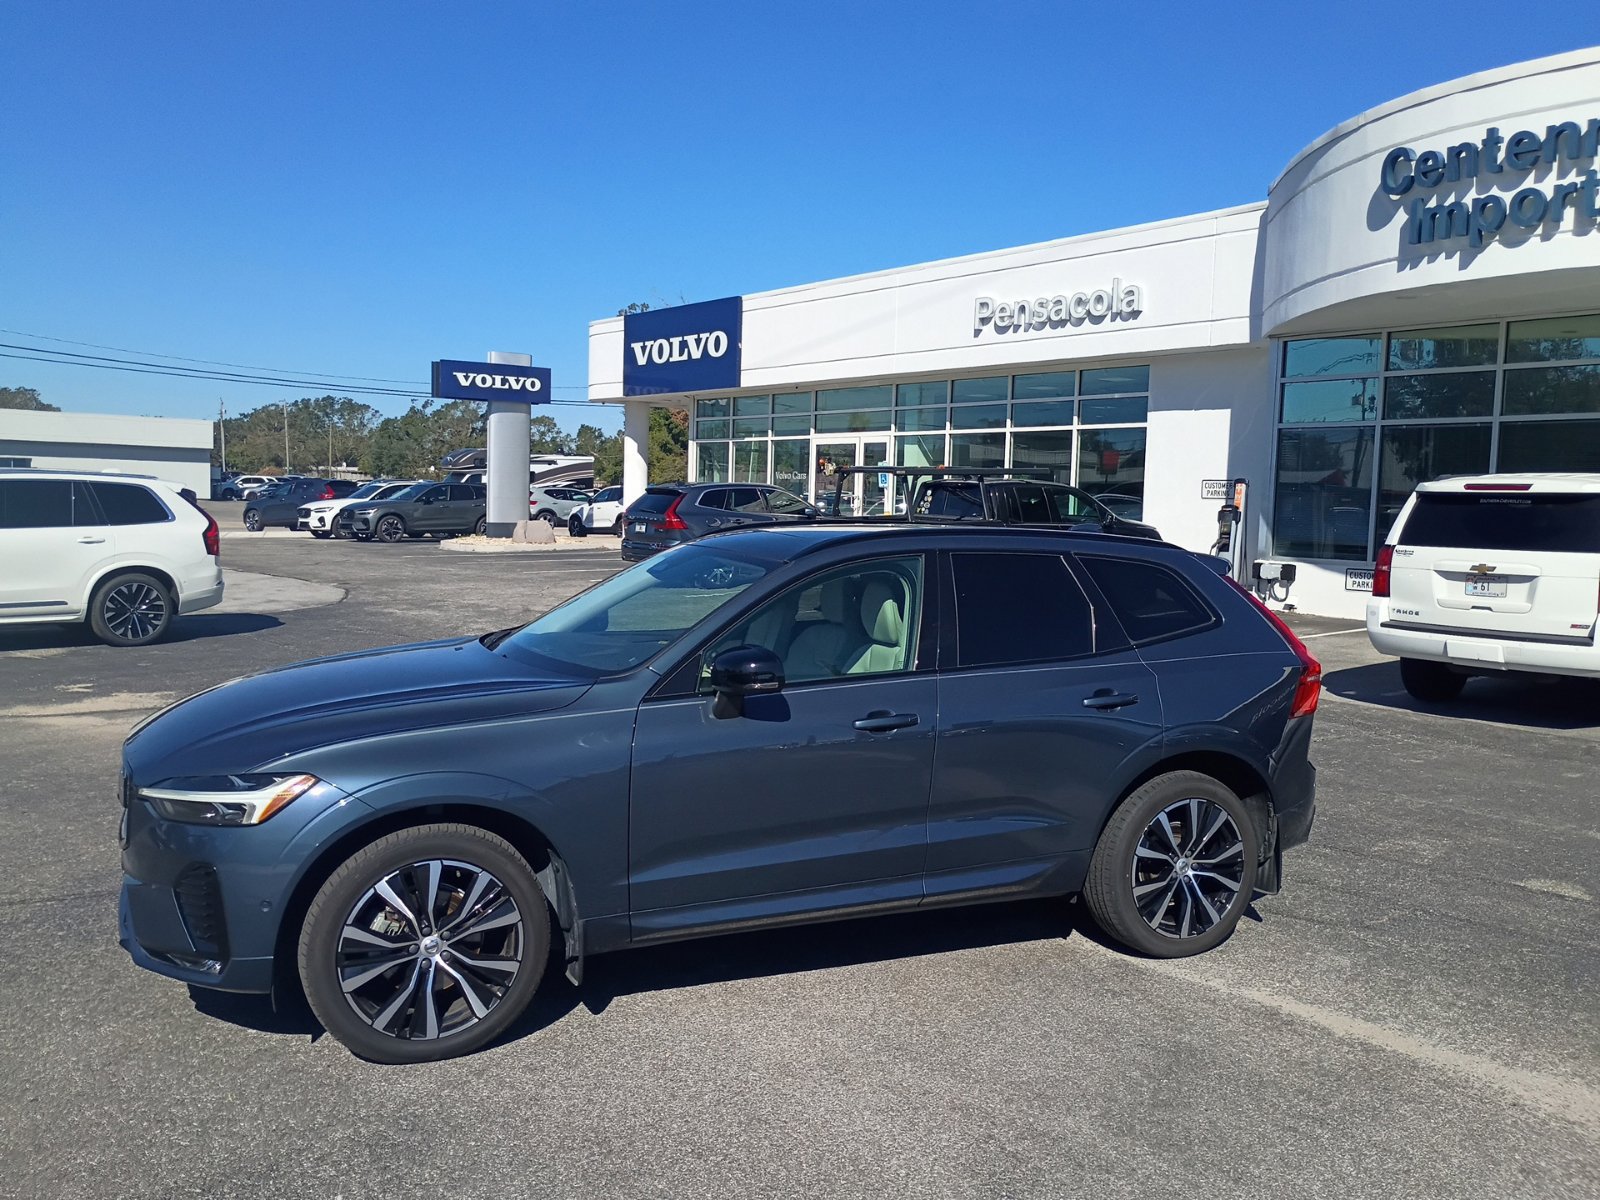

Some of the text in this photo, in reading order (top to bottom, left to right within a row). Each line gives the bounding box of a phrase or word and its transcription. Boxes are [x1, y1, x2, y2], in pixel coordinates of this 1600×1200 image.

[974, 277, 1141, 332] Pensacola
[631, 331, 728, 366] VOLVO
[453, 371, 542, 392] VOLVO
[775, 471, 807, 480] Volvo Cars
